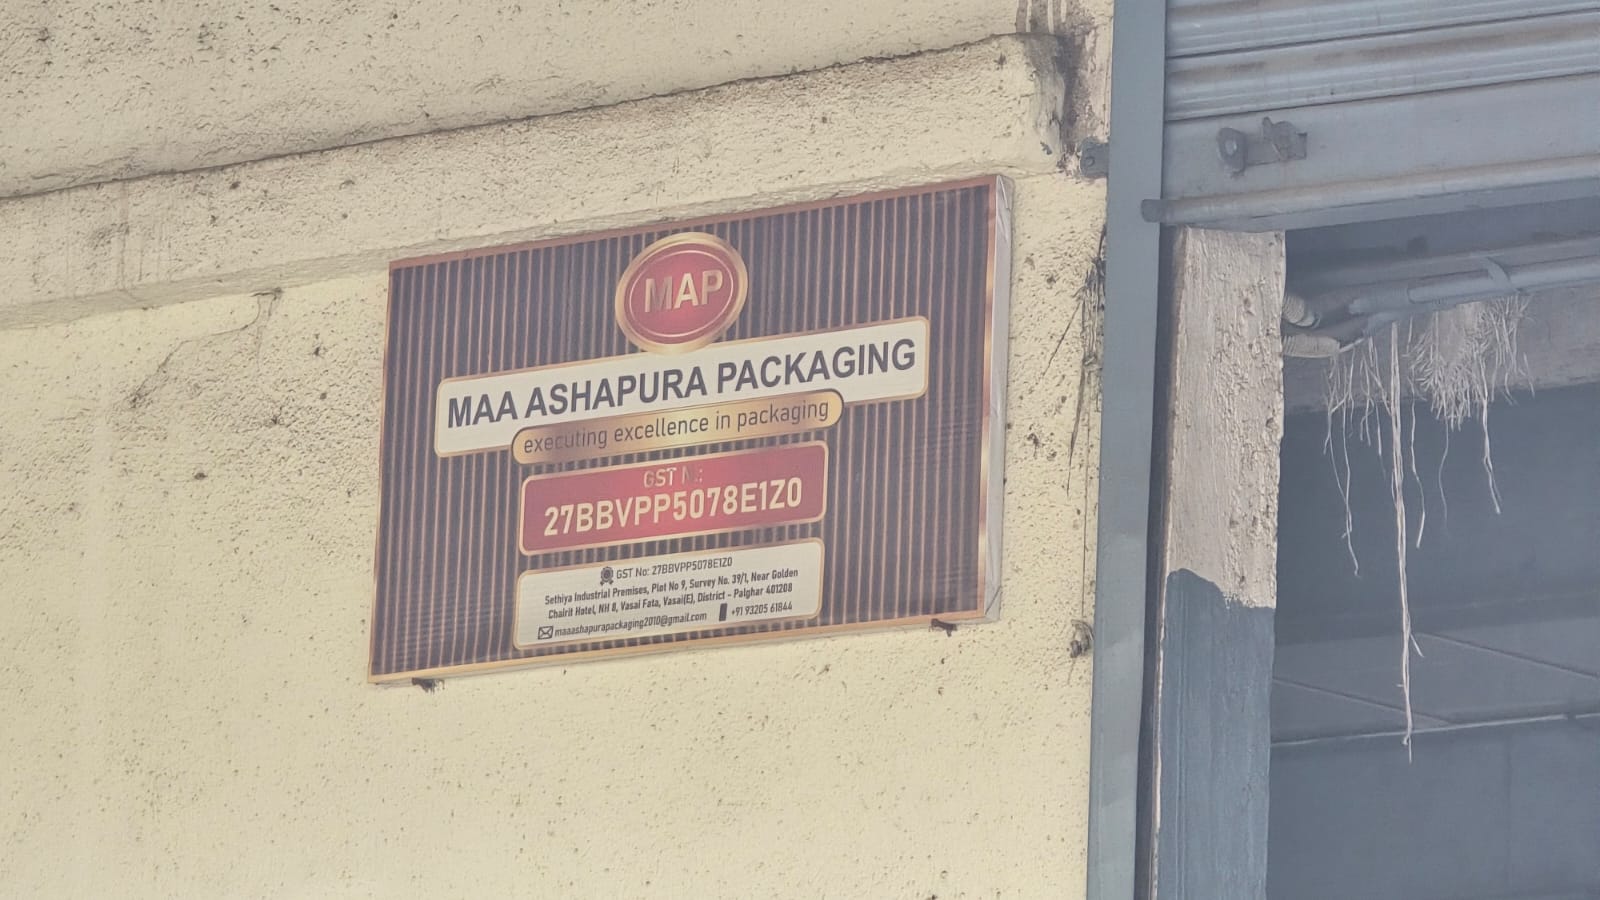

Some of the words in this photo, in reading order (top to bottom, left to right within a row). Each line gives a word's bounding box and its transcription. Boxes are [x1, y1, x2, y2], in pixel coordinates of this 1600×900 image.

[644, 269, 723, 313] MAP
[447, 391, 518, 429] MAA
[524, 365, 708, 419] ASHAPURA
[717, 338, 916, 394] PACKAGING
[523, 428, 608, 455] executing
[613, 414, 709, 443] excellence
[715, 409, 731, 430] in
[737, 399, 830, 432] packaging
[643, 467, 676, 488] GST
[543, 476, 803, 537] 27BBVPP5078E1Z0
[544, 594, 572, 606] Sethiya
[574, 588, 610, 602] Industrial
[612, 586, 649, 597] Premises,
[651, 582, 667, 593] Plot
[668, 580, 679, 591] No
[681, 579, 688, 591] 9,
[690, 578, 716, 590] Survey
[717, 574, 730, 585] No.
[750, 569, 770, 582] Near
[772, 568, 798, 580] Golden
[616, 567, 634, 580] GST
[635, 565, 650, 577] No:
[652, 556, 732, 575] 27BBVPP5078E1Z0
[575, 604, 596, 616] Hotel,
[598, 601, 610, 614] NH
[611, 600, 619, 613] 8,
[642, 597, 661, 608] Fata,
[697, 588, 725, 602] District
[733, 586, 764, 600] Palghar
[766, 582, 792, 594] 401208
[732, 606, 743, 616] +91
[745, 603, 768, 616] 93205
[770, 600, 792, 612] 61844
